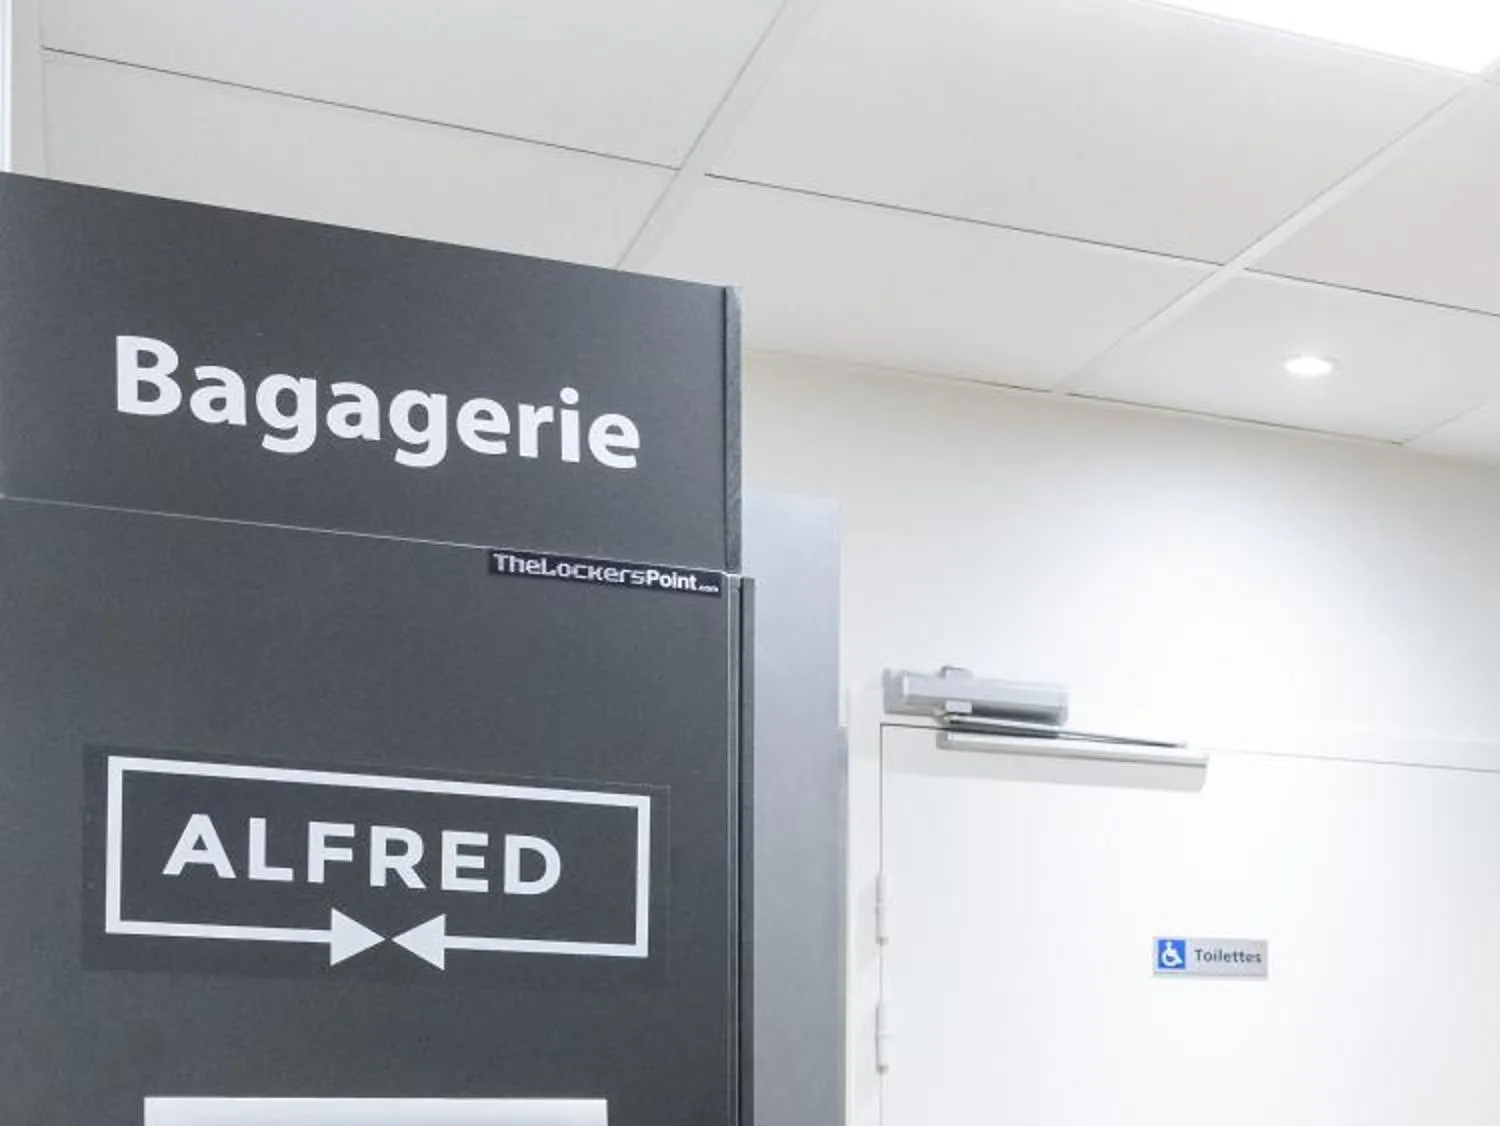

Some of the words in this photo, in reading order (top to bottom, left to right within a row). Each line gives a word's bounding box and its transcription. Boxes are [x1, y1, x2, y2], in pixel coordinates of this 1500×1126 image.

[118, 336, 642, 470] Bagagerie
[162, 814, 562, 896] ALFRED
[1193, 948, 1262, 963] Toilettes
